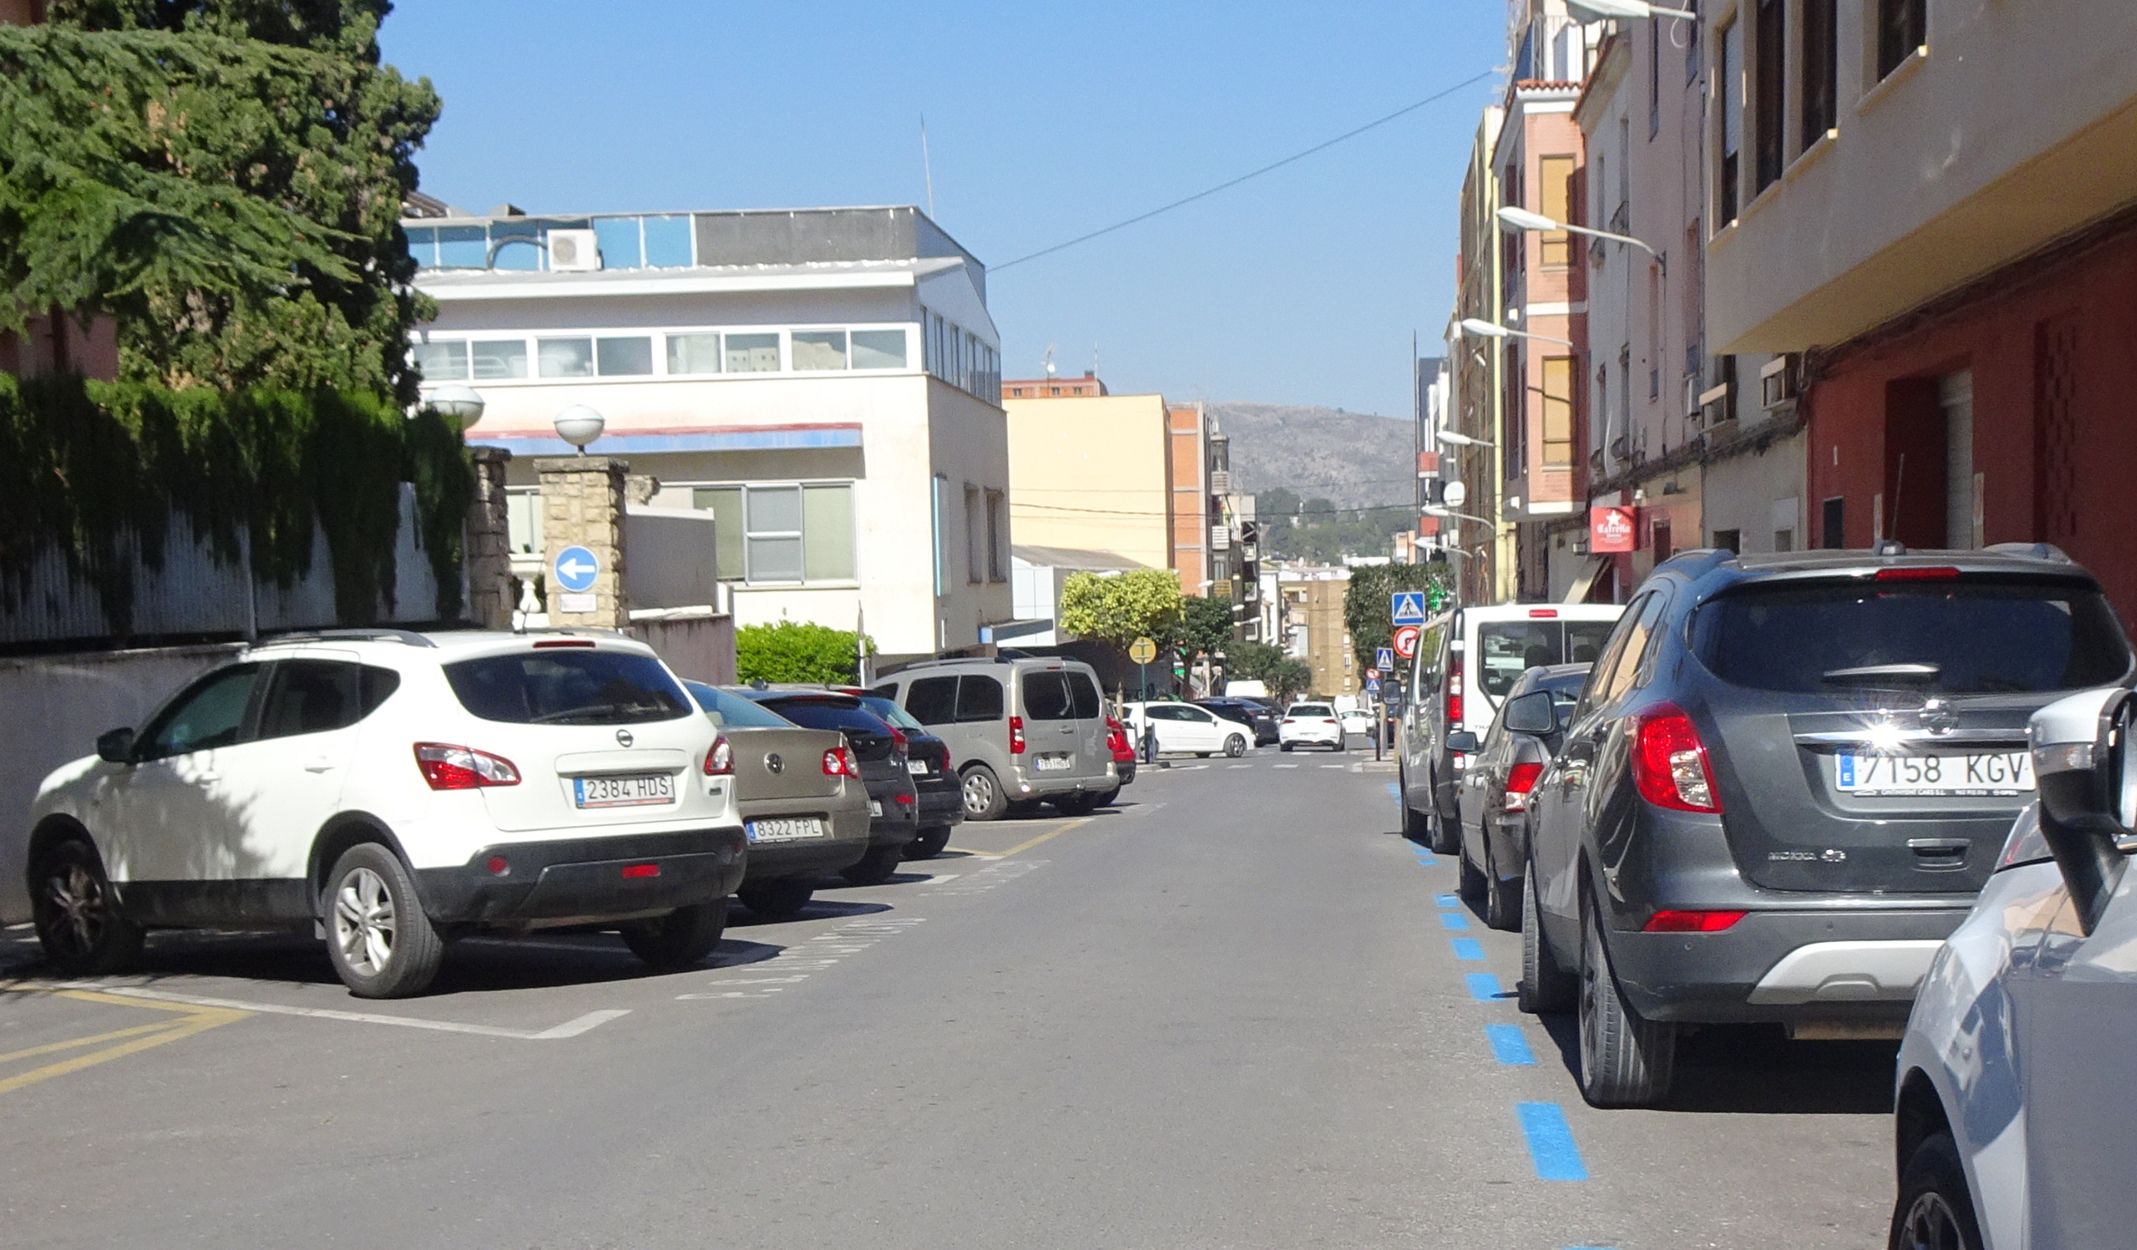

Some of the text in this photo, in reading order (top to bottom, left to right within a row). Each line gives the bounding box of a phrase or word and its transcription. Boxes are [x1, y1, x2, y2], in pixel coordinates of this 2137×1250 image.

[1863, 754, 1942, 784] 7158
[1965, 752, 2025, 784] KGV
[588, 777, 668, 800] 2384 HDS
[757, 818, 819, 837] 8322 FPL
